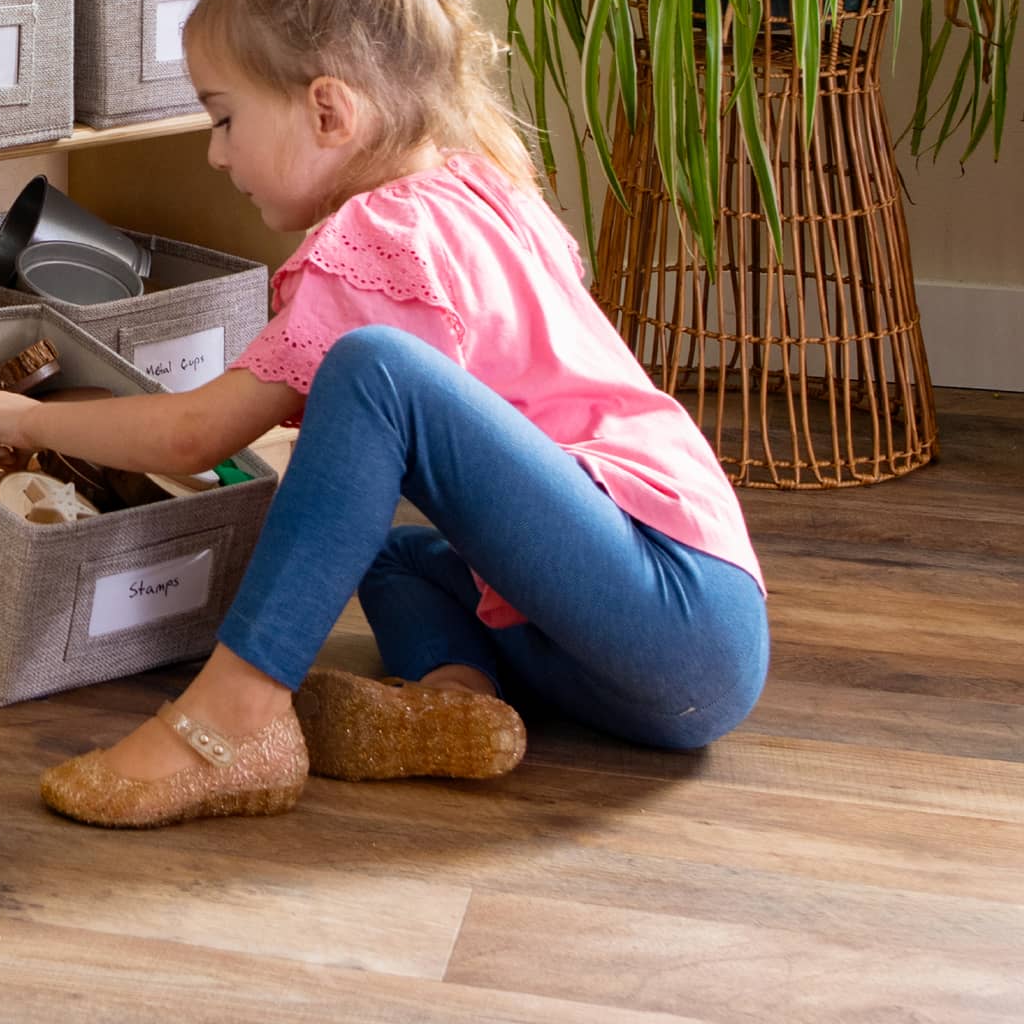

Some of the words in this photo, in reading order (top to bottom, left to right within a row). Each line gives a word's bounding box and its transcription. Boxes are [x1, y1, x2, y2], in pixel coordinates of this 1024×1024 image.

[145, 360, 172, 377] Metal
[180, 355, 205, 371] Cups
[129, 577, 180, 598] Stamps
